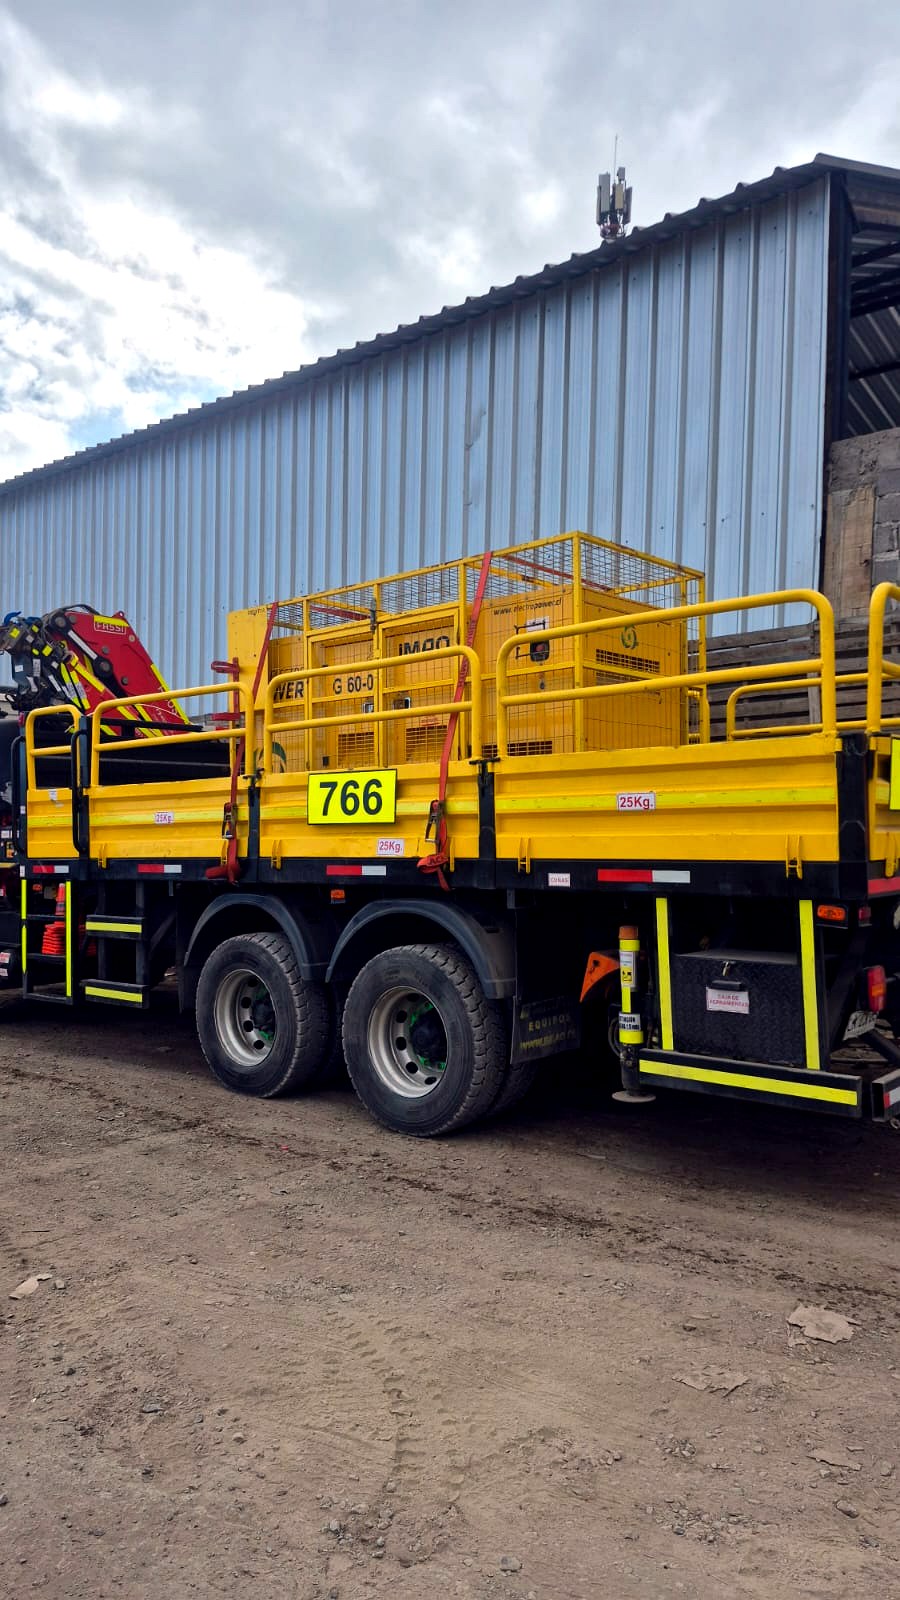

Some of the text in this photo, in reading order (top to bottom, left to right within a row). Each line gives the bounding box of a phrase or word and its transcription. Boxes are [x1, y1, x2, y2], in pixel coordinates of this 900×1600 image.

[333, 678, 342, 695] G
[319, 778, 383, 817] 766
[620, 796, 654, 810] 25Kg.
